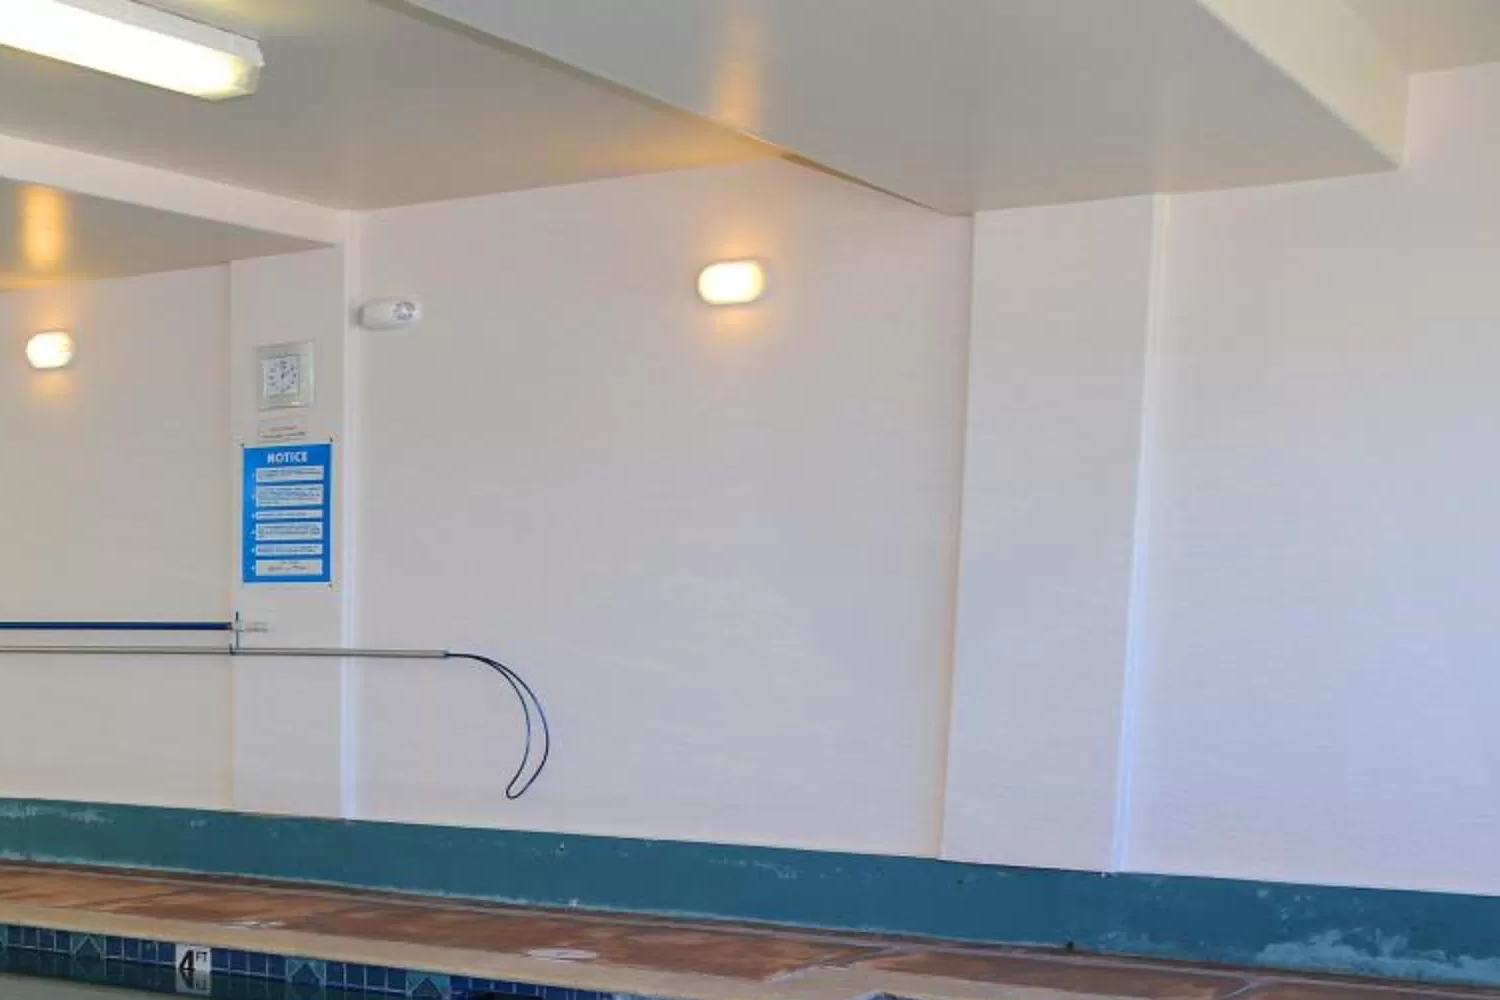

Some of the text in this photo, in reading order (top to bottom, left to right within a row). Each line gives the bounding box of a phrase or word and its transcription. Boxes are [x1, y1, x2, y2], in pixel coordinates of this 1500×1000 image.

[267, 451, 308, 464] NOTICE
[179, 950, 208, 972] 4 FT
